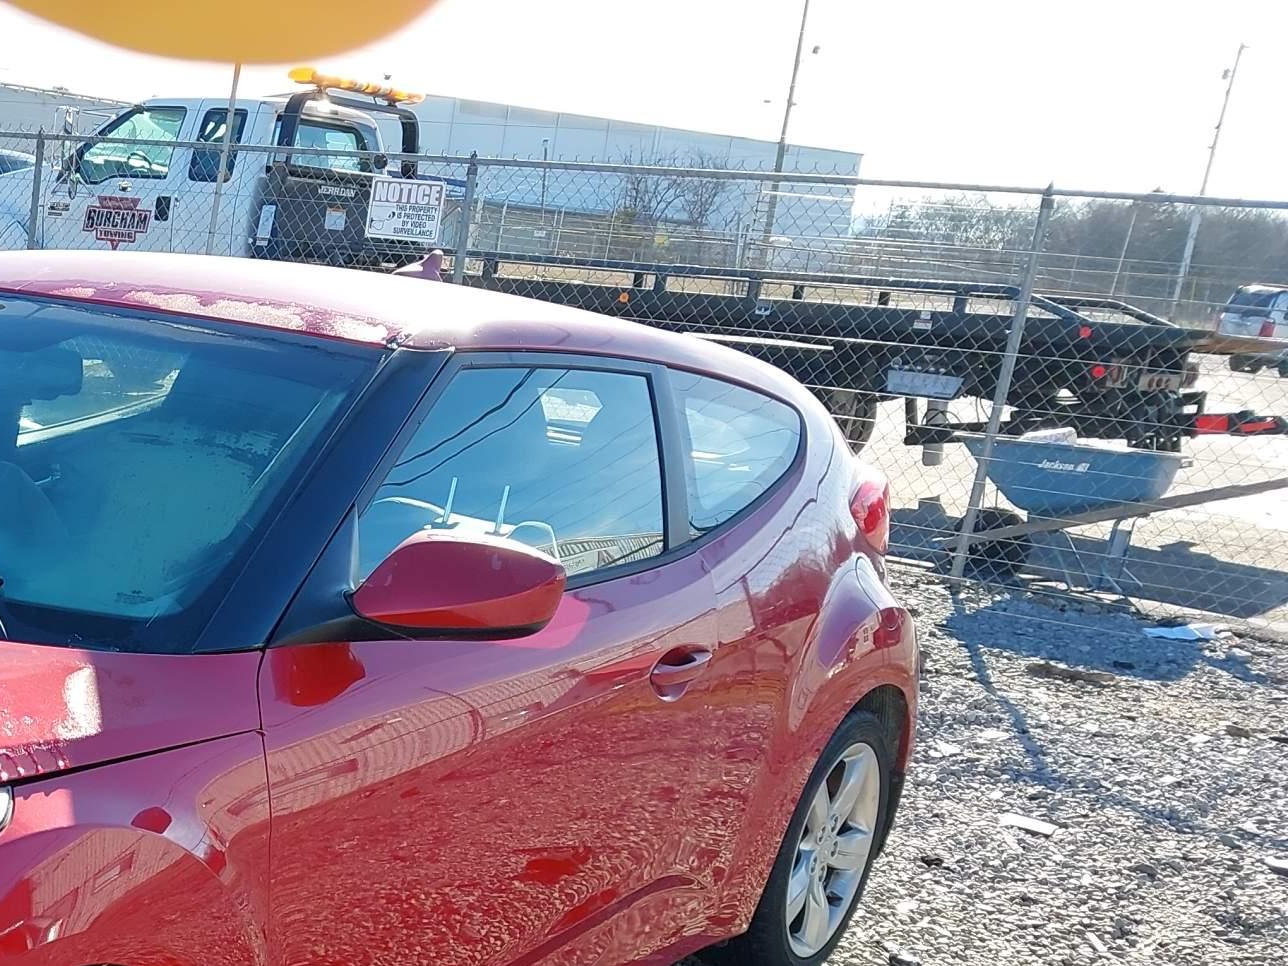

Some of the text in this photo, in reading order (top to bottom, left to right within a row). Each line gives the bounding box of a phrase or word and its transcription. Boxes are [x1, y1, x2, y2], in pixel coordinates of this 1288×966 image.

[374, 181, 441, 205] NOTICE
[408, 206, 438, 214] PROPERTY
[86, 208, 149, 230] BURCHAM
[403, 213, 436, 221] PROTECTED
[98, 229, 134, 239] TOWING
[393, 227, 433, 237] SURVEILLANCE
